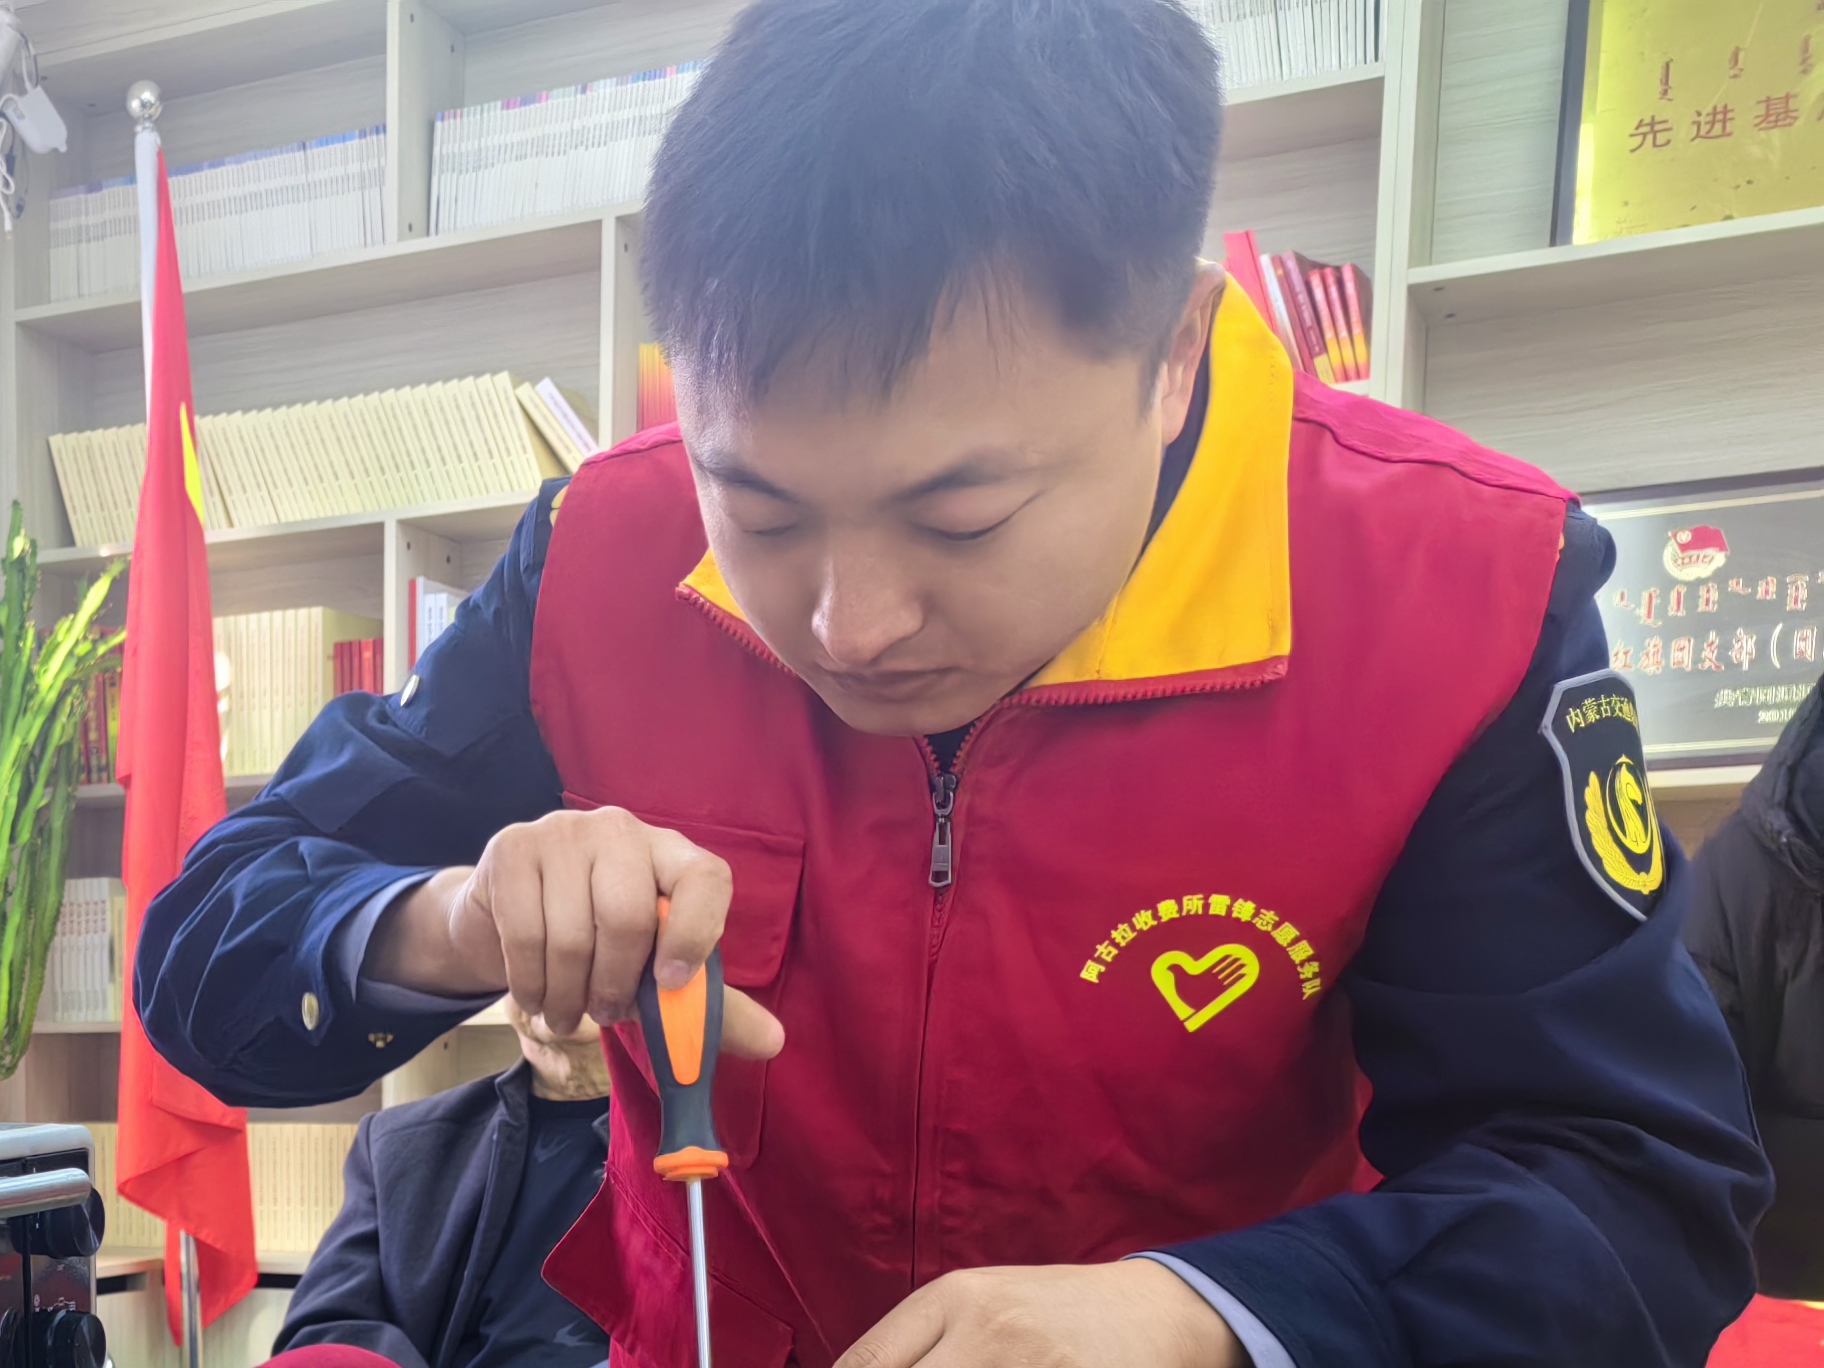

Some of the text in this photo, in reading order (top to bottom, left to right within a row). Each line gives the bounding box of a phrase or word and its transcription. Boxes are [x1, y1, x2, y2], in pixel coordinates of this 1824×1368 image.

[1628, 92, 1824, 153] 先进基
[1565, 692, 1640, 737] 内蒙古交通
[1079, 893, 1322, 1001] 阿古拉收费所雷锋志愿服务队
